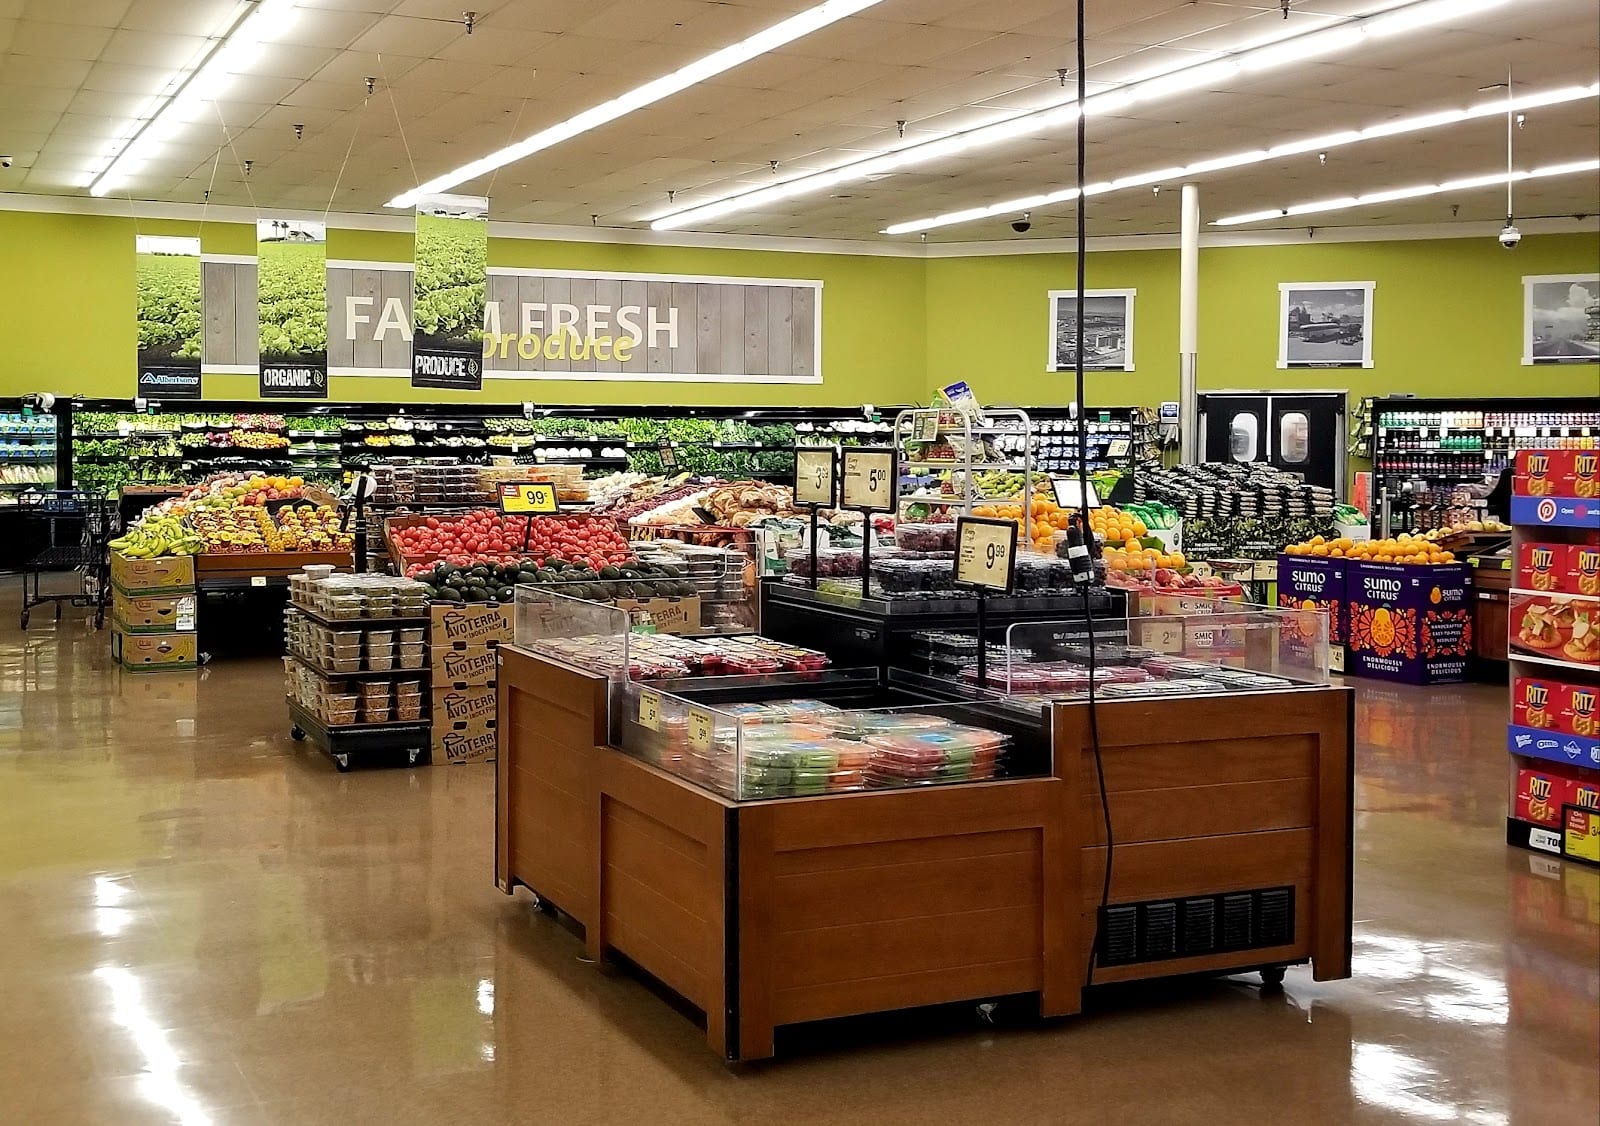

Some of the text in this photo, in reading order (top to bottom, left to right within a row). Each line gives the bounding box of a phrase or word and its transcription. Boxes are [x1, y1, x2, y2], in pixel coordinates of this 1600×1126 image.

[522, 302, 679, 349] FRESH
[483, 325, 635, 362] produce
[414, 354, 467, 377] PRODUCE
[157, 375, 199, 385] Albertsons
[263, 369, 312, 387] ORGANIC
[1528, 455, 1550, 474] RITZ
[1575, 455, 1598, 474] RITZ
[1532, 549, 1554, 568] RITZ
[1579, 551, 1600, 571] RITZ
[1292, 570, 1326, 584] SUMO
[1363, 577, 1402, 592] SUMO
[1294, 582, 1324, 593] CITRUS
[1366, 590, 1399, 601] CITRUS
[1442, 589, 1463, 597] SUMO
[447, 611, 501, 639] AVOTERRA
[447, 653, 495, 679] AVOTERR
[1362, 655, 1403, 667] ENORMOUSLY
[1367, 663, 1399, 673] DELICIOUS
[1431, 668, 1462, 676] DELICIOUS
[1526, 685, 1549, 704] RITZ
[1572, 691, 1596, 711] RITZ
[447, 694, 496, 720] AVOTERR
[1530, 776, 1552, 798] RITZ
[1576, 788, 1600, 809] RITZ
